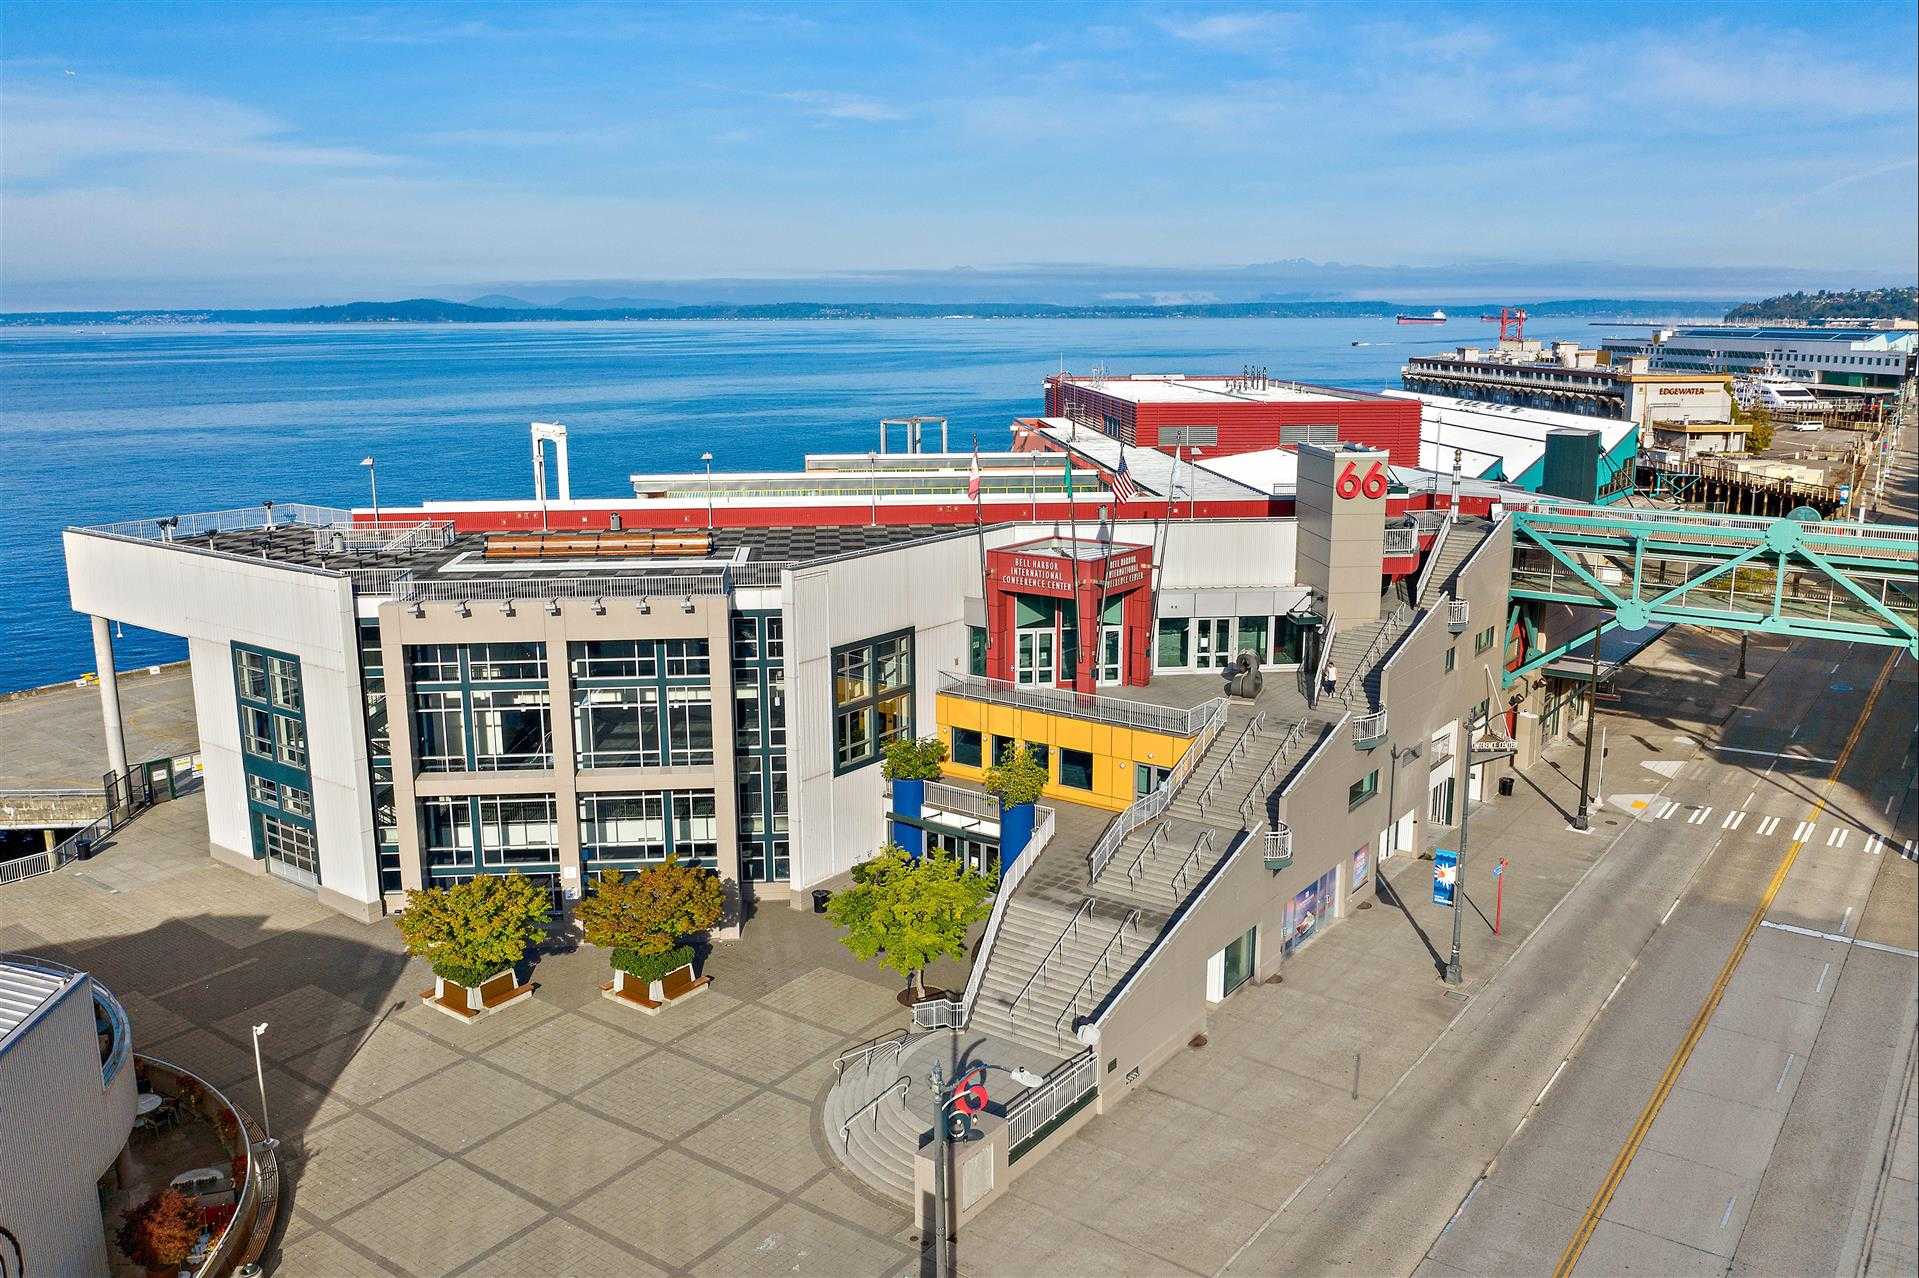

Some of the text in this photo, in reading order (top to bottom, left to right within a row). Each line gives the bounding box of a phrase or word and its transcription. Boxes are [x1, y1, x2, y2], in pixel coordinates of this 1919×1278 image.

[1659, 387, 1705, 395] EDGEWATER
[1336, 460, 1388, 500] 66
[1014, 558, 1059, 571] BELL HARBOR
[1010, 566, 1064, 581] INTERNATIONAL
[1002, 575, 1073, 592] CONFERENCE CENTER
